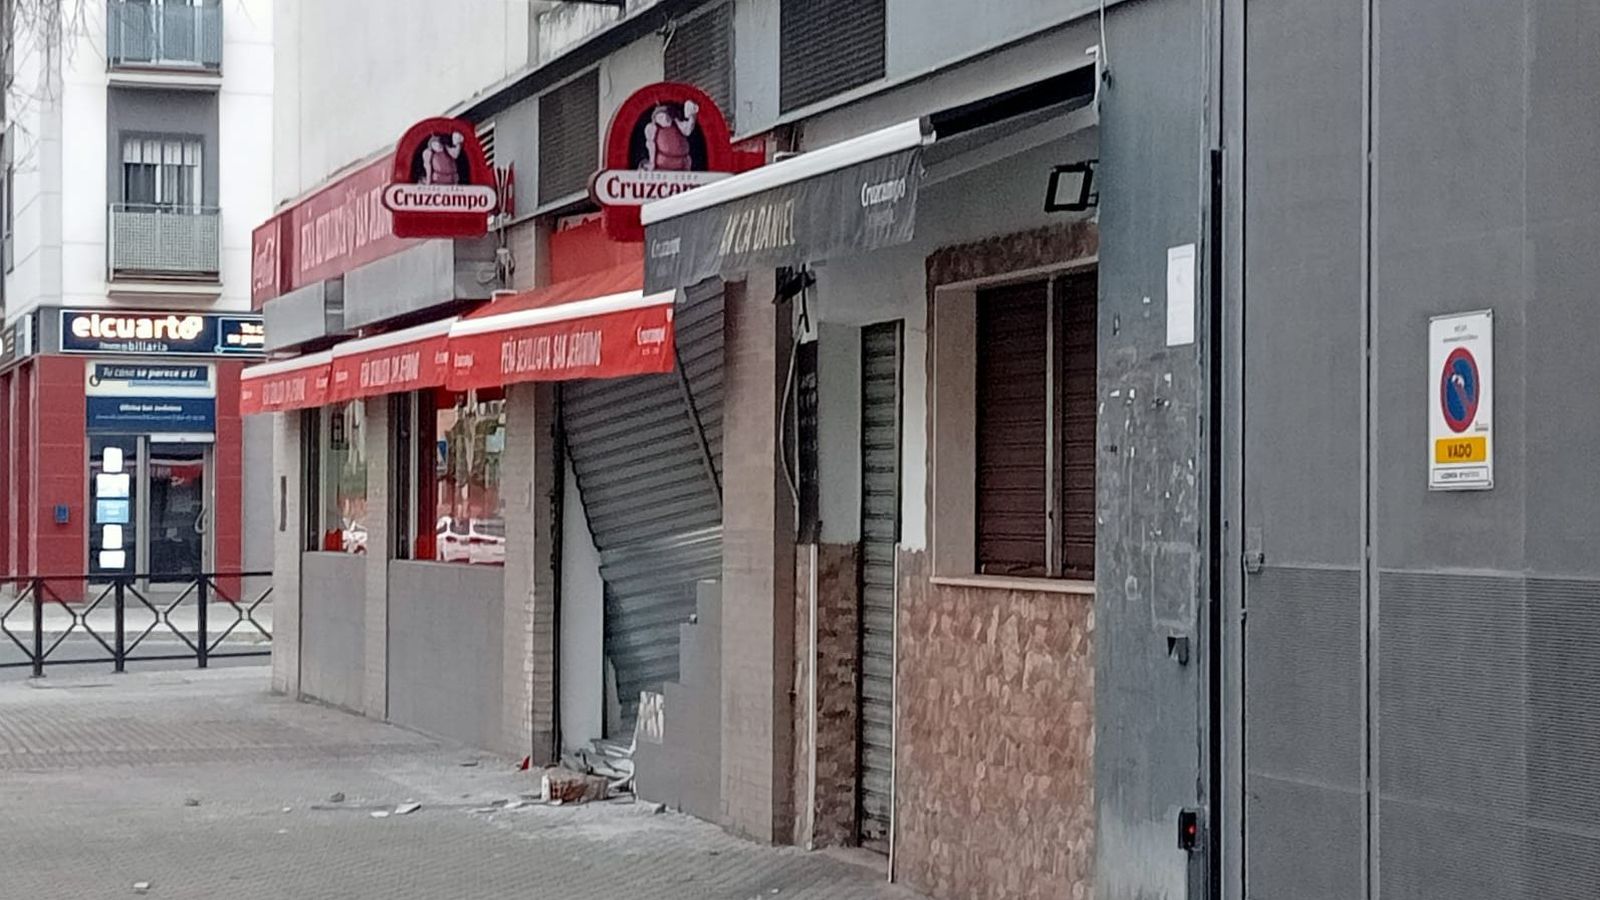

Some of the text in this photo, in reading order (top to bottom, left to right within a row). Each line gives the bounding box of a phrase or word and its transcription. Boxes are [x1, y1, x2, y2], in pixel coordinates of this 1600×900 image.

[393, 188, 488, 210] Cruzcampo
[752, 199, 796, 251] DANIEL
[72, 314, 203, 340] elcuarto
[1447, 443, 1472, 459] VADO
